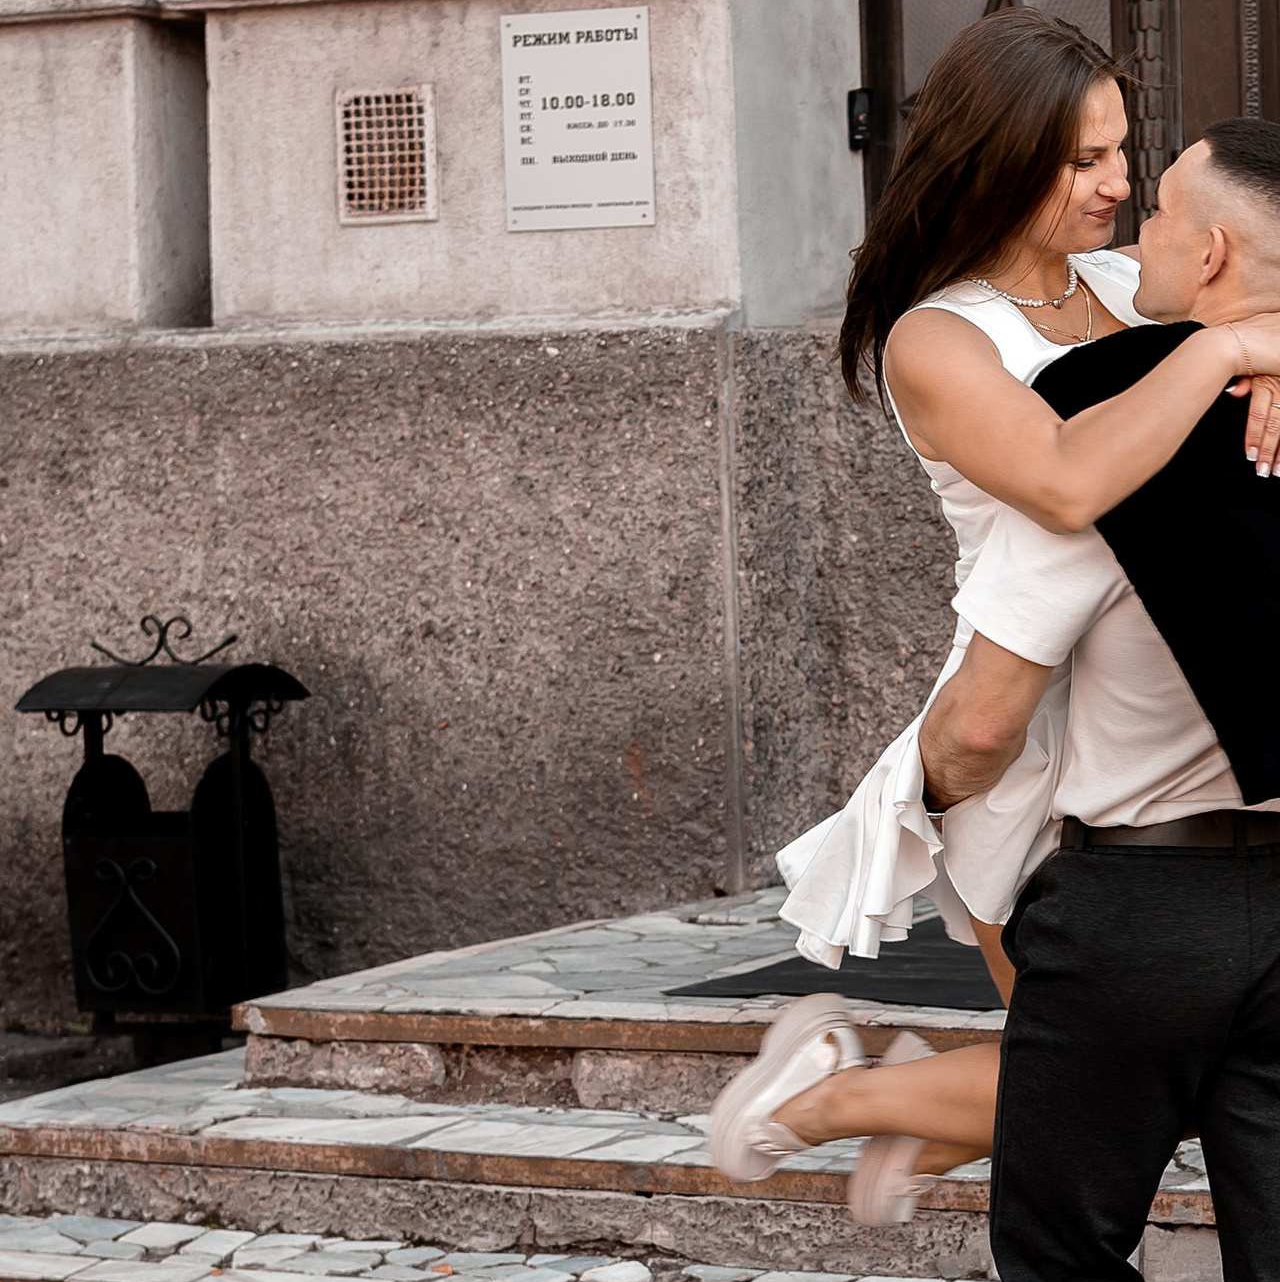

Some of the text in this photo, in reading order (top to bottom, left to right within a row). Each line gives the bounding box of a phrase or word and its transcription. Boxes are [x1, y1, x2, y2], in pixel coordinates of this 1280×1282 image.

[512, 27, 640, 48] РЕЖИМ РАБОТЫ
[541, 92, 636, 111] 10.00-18.00
[552, 152, 608, 165] ВЫХОДНОЙ
[610, 151, 638, 162] ДЕНЬ
